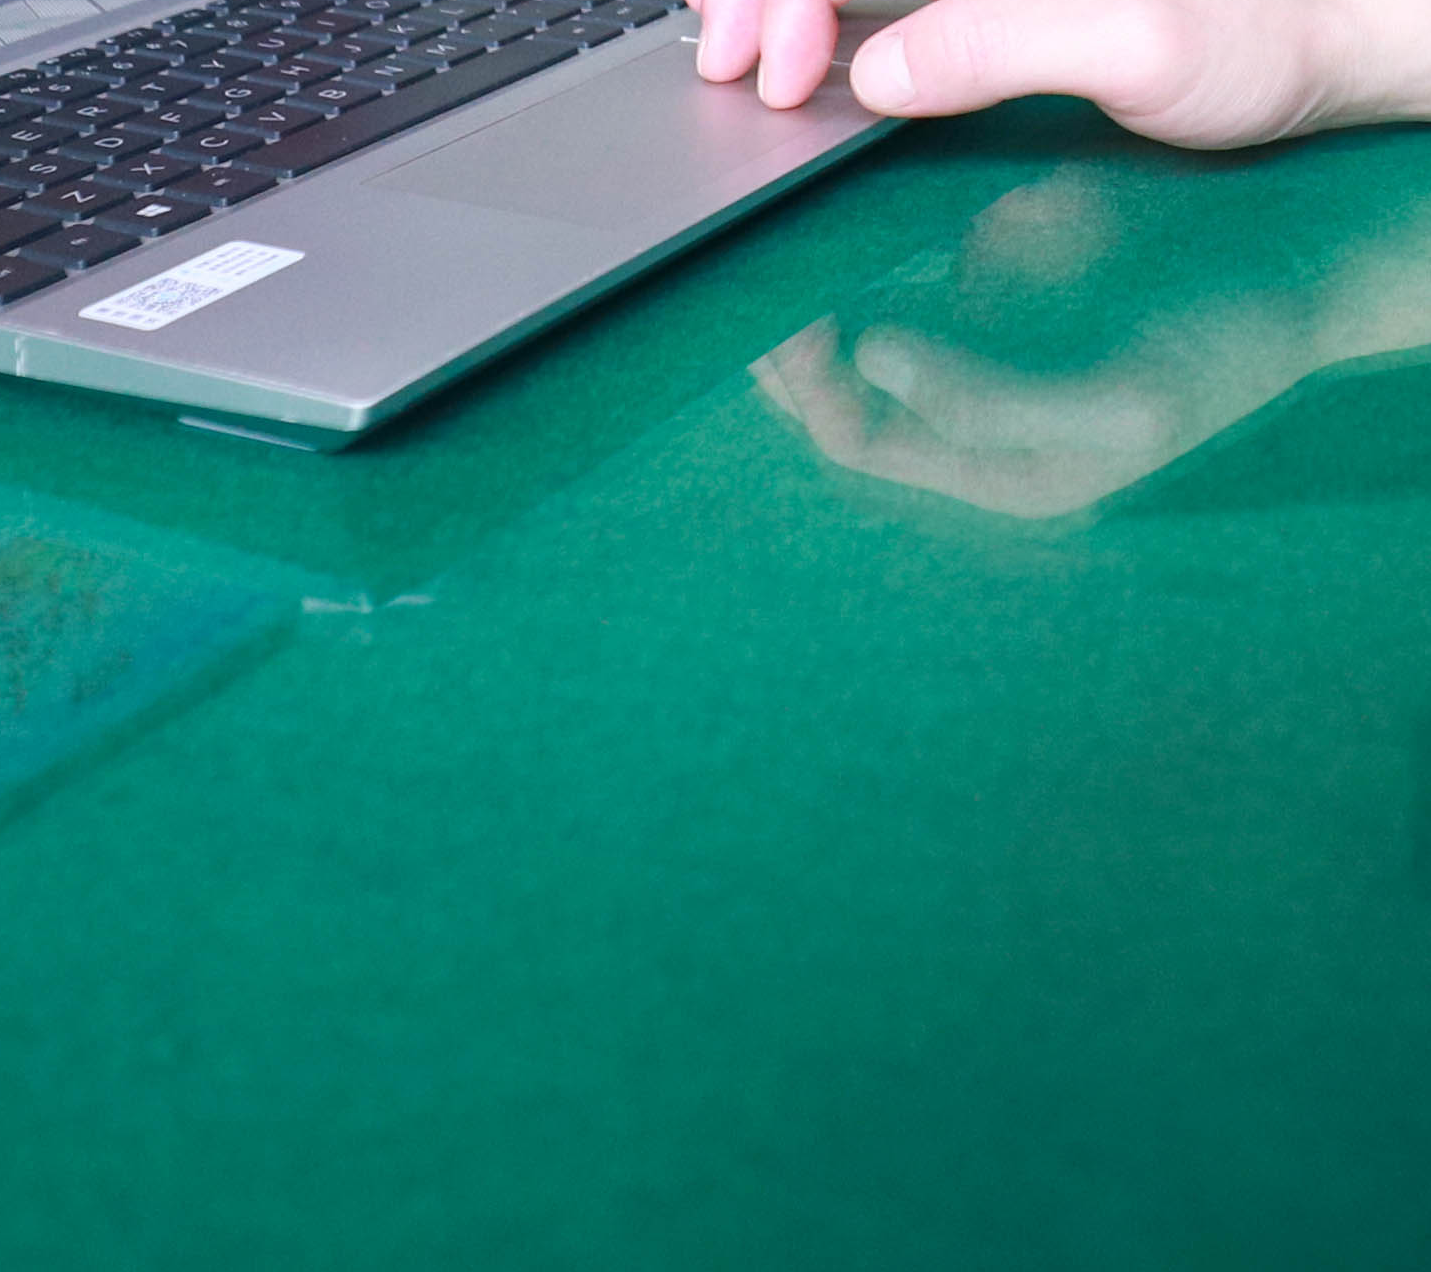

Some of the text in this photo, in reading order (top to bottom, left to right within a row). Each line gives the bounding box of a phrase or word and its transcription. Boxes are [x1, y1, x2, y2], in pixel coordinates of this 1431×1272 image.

[258, 38, 286, 49] U
[344, 43, 363, 53] J
[426, 43, 458, 55] M
[200, 59, 225, 69] Y
[280, 65, 311, 76] H
[374, 65, 404, 76] N
[140, 82, 166, 92] T
[225, 87, 252, 98] G
[319, 88, 347, 100] B
[76, 106, 109, 117] R
[160, 111, 182, 123] F
[258, 111, 286, 122] V
[11, 130, 44, 142] E
[94, 136, 125, 149] D
[200, 136, 229, 148] C
[28, 162, 58, 175] S
[130, 162, 166, 175] X
[60, 189, 97, 203] Z
